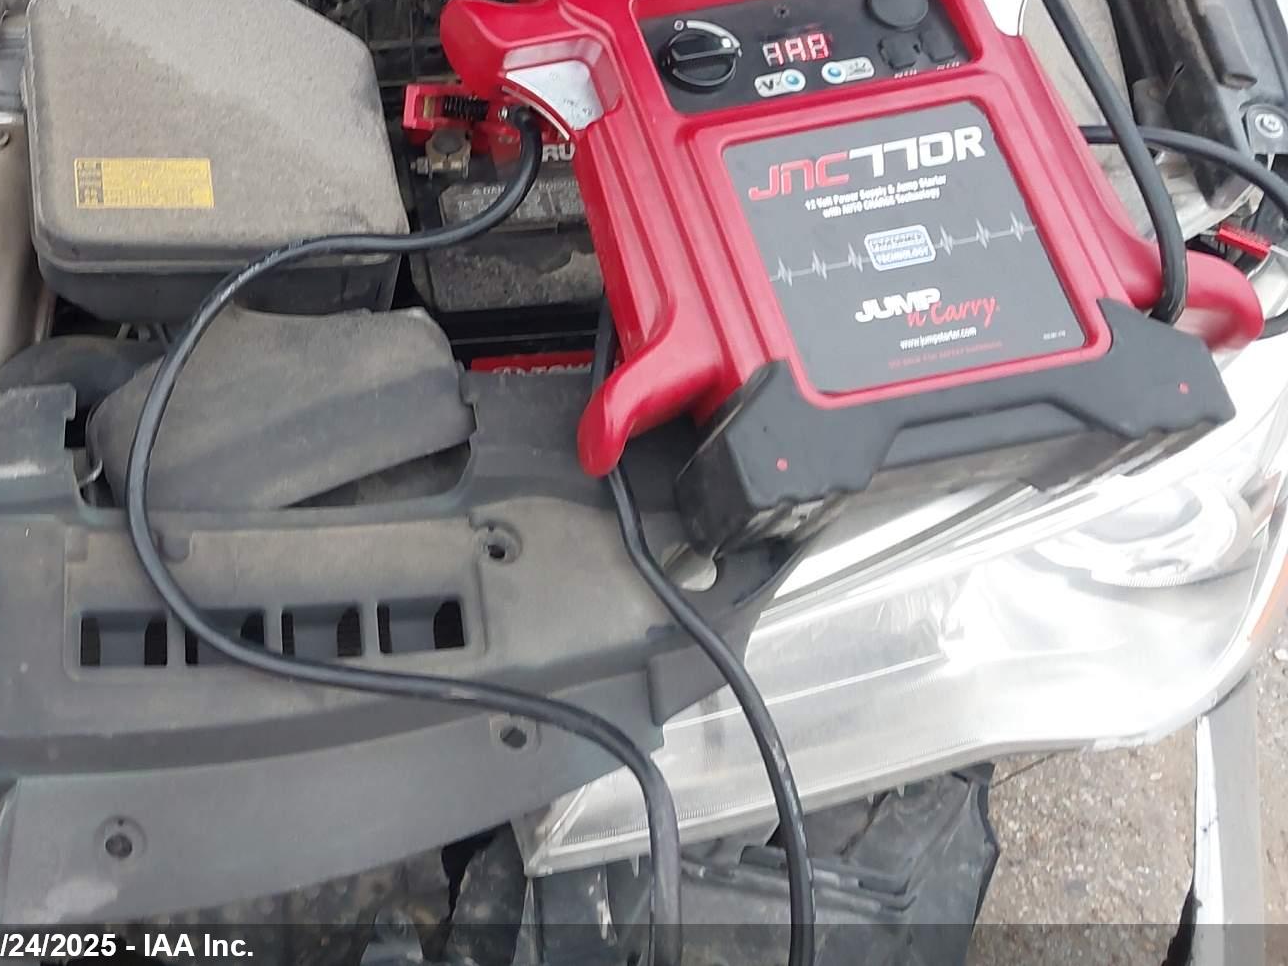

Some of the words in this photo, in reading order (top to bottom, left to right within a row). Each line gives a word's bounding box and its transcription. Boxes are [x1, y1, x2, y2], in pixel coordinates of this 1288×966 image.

[816, 195, 833, 209] Volt
[833, 191, 859, 205] Power
[859, 186, 887, 202] Supply
[896, 180, 918, 194] Jump
[918, 175, 947, 188] Starter
[822, 206, 842, 219] with
[855, 287, 941, 323] JUMP
